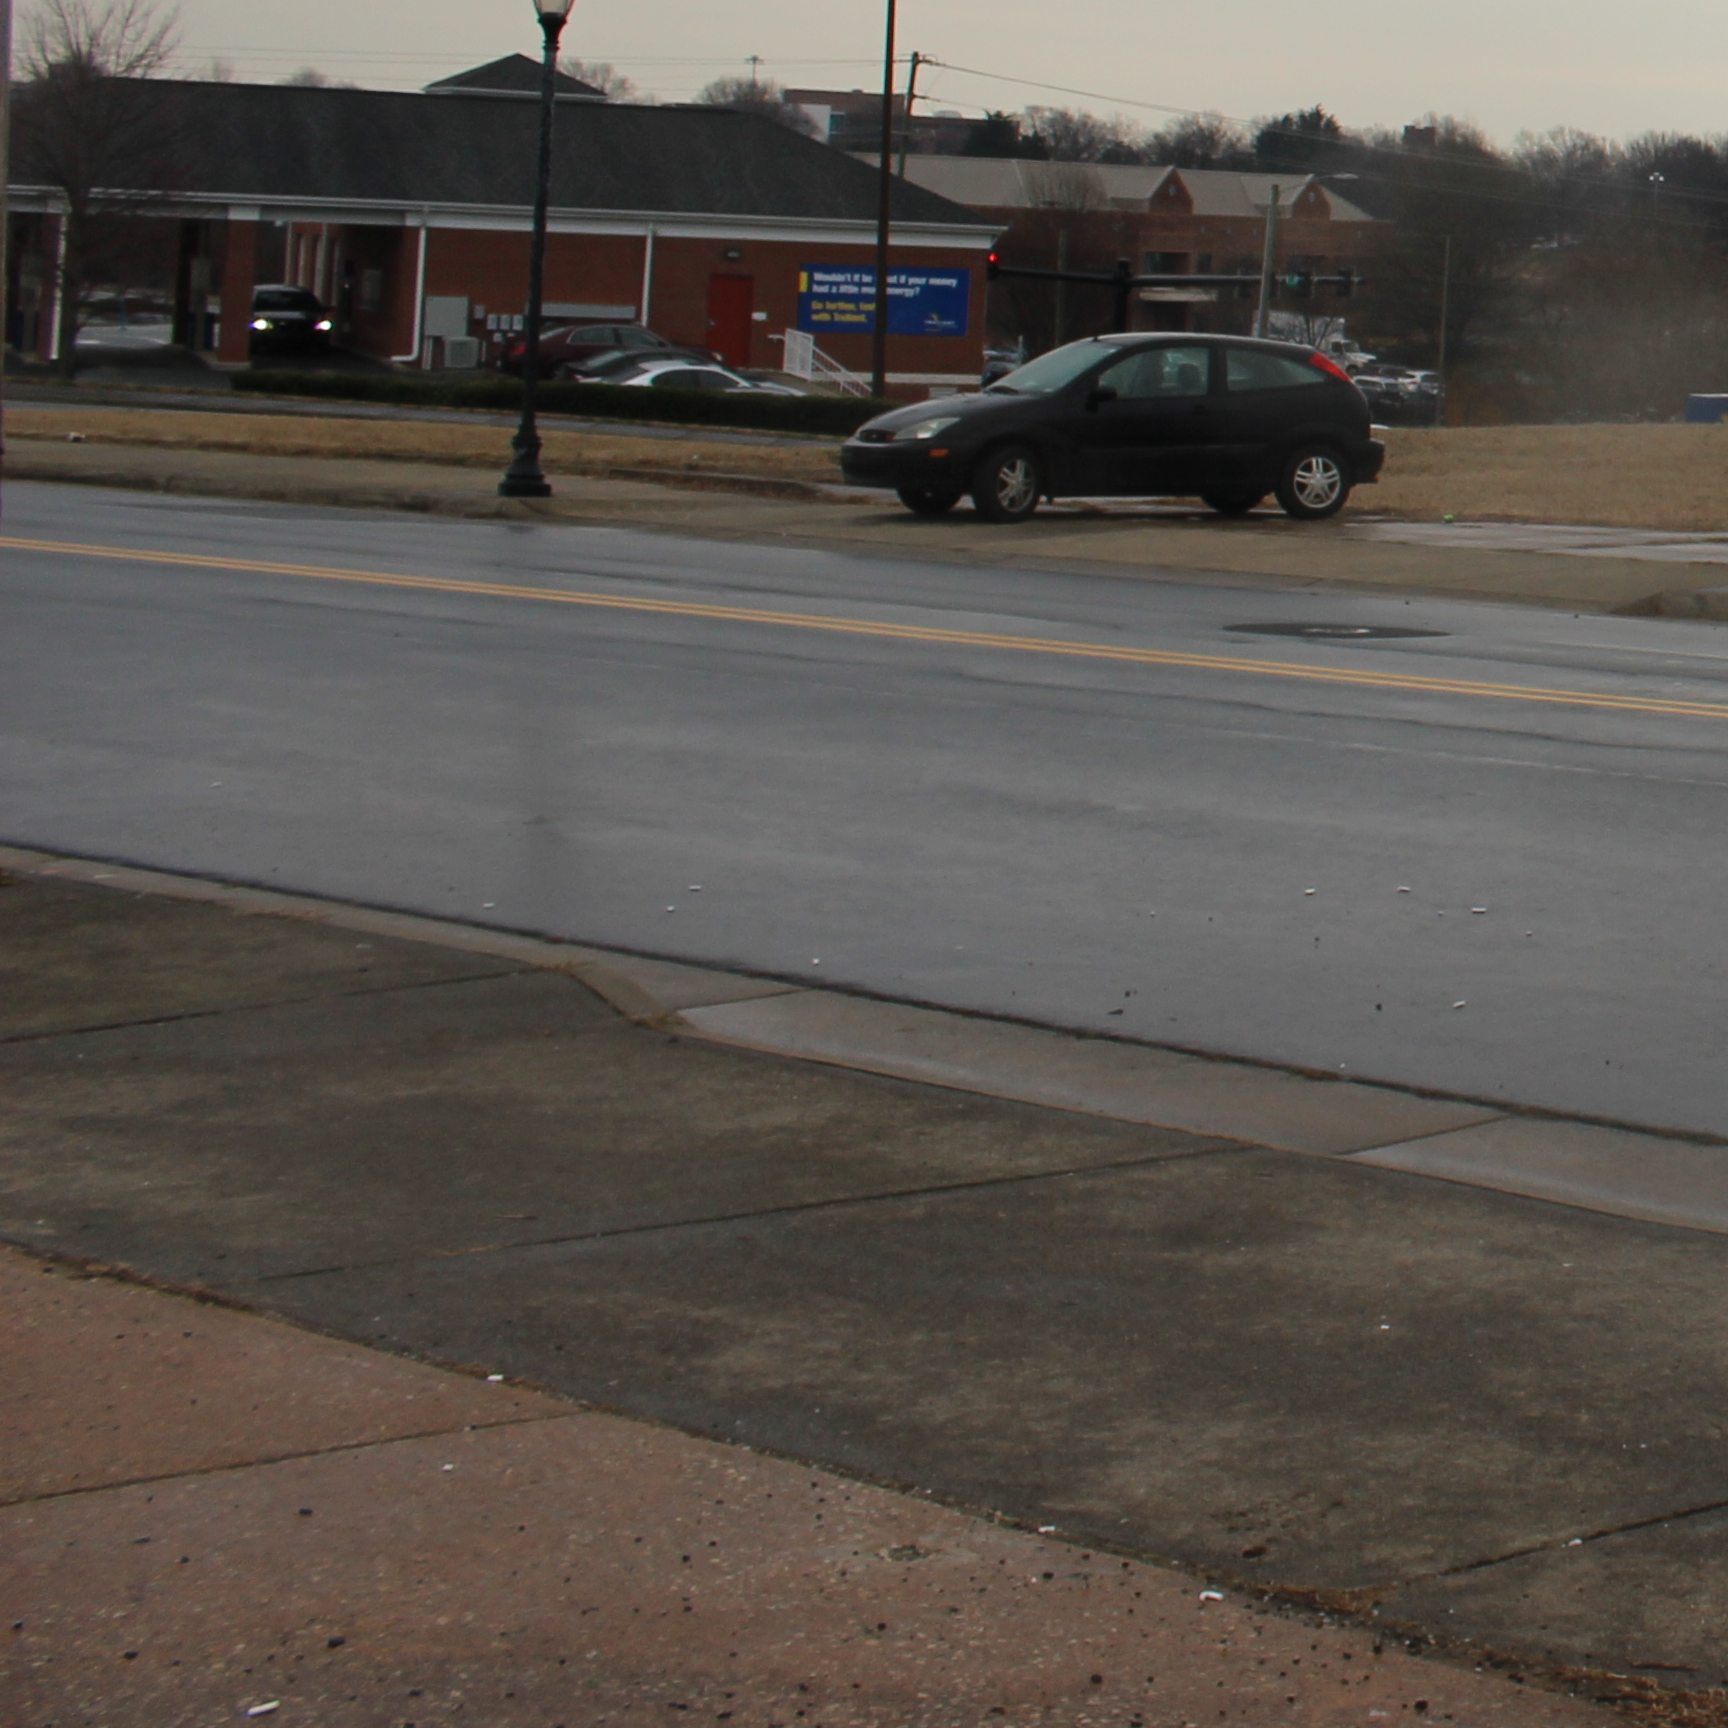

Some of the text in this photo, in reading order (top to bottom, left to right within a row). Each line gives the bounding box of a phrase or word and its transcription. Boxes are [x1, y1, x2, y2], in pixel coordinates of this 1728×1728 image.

[813, 272, 851, 282] Wouldn't
[853, 273, 860, 283] it
[861, 273, 873, 283] be
[908, 277, 927, 286] your
[928, 277, 958, 288] money
[812, 284, 830, 293] had
[839, 284, 859, 294] little
